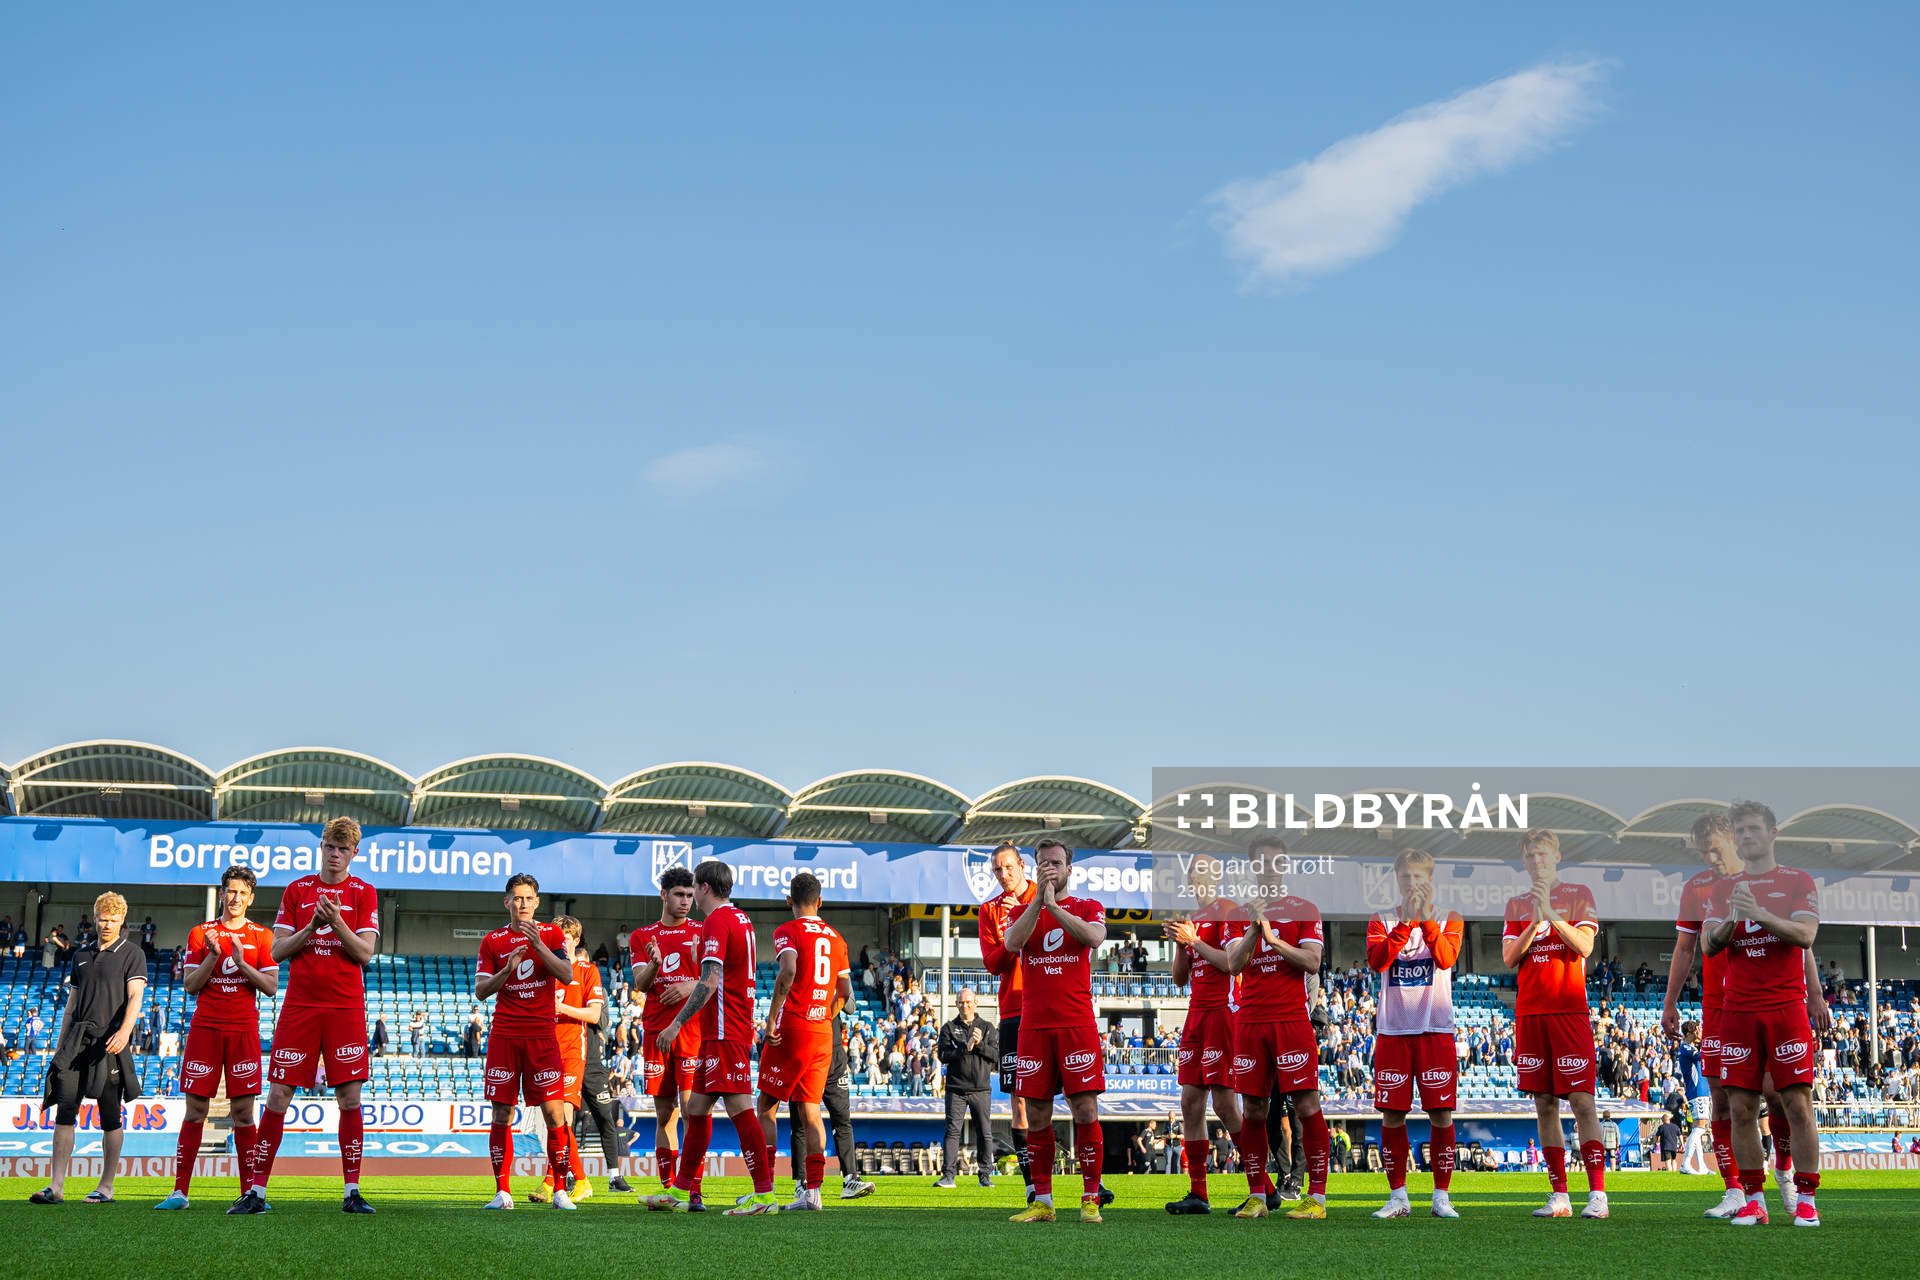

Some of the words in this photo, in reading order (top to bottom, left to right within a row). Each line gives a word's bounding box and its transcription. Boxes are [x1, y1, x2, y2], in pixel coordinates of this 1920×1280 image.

[150, 833, 513, 878] Borregaa-tribunen
[734, 913, 752, 924] B
[314, 947, 331, 956] Vest
[1745, 948, 1766, 958] Vest
[814, 937, 831, 985] 6
[1028, 954, 1079, 966] Sparebanken
[1532, 954, 1550, 963] Vest
[1044, 965, 1062, 975] Vest
[1260, 964, 1278, 974] Vest
[1392, 965, 1431, 979] LERØY
[221, 985, 238, 993] Vest
[518, 991, 535, 999] Vest
[275, 1048, 306, 1062] LERØY
[336, 1045, 366, 1057] LERØY
[1775, 1042, 1807, 1057] LERØY
[1017, 1058, 1042, 1070] ERØY
[1065, 1052, 1096, 1066] LERØY
[1277, 1052, 1309, 1064] LERØY
[1518, 1056, 1544, 1067] ERØY
[1557, 1056, 1588, 1067] LERØY
[186, 1061, 213, 1074] LERØY
[233, 1061, 258, 1073] LERØY
[644, 1062, 665, 1072] ERØY
[272, 1067, 286, 1080] 43
[533, 1070, 561, 1083] LERØY
[1004, 1073, 1012, 1085] 12
[1377, 1071, 1409, 1083] LERØY
[1422, 1070, 1452, 1082] LERØY
[486, 1084, 496, 1097] 13
[1137, 1080, 1157, 1090] MED
[1160, 1080, 1173, 1090] ET
[260, 1104, 324, 1126] DO
[361, 1104, 424, 1126] BDO
